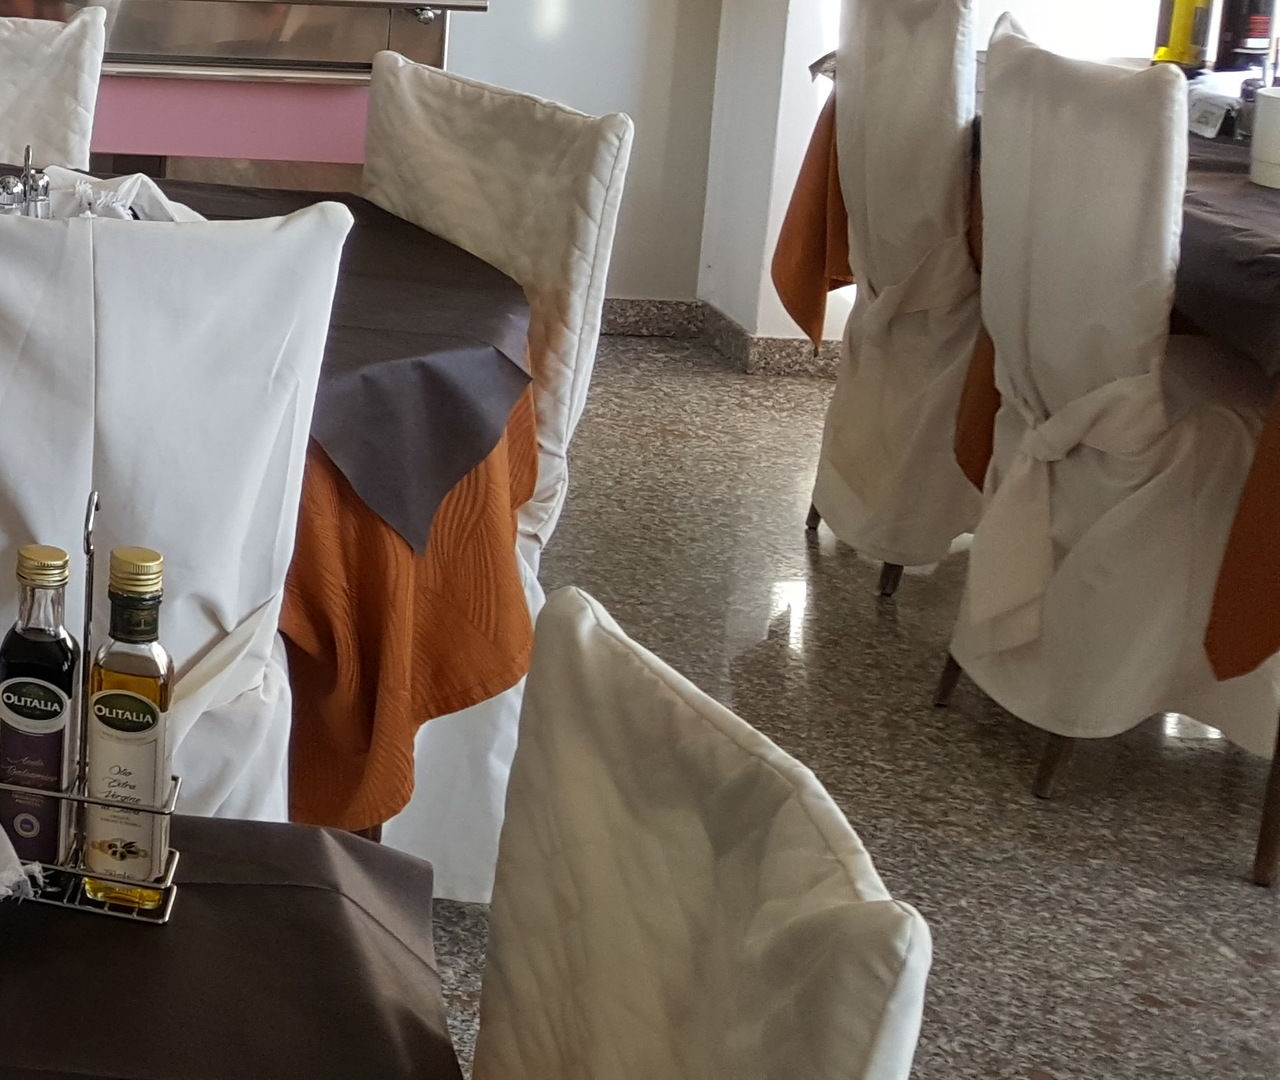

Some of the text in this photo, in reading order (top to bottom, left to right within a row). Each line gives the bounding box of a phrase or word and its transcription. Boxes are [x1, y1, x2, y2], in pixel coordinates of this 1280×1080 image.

[2, 692, 61, 713] OLITALIA
[93, 704, 153, 724] OLITALIA
[108, 764, 133, 778] Olio
